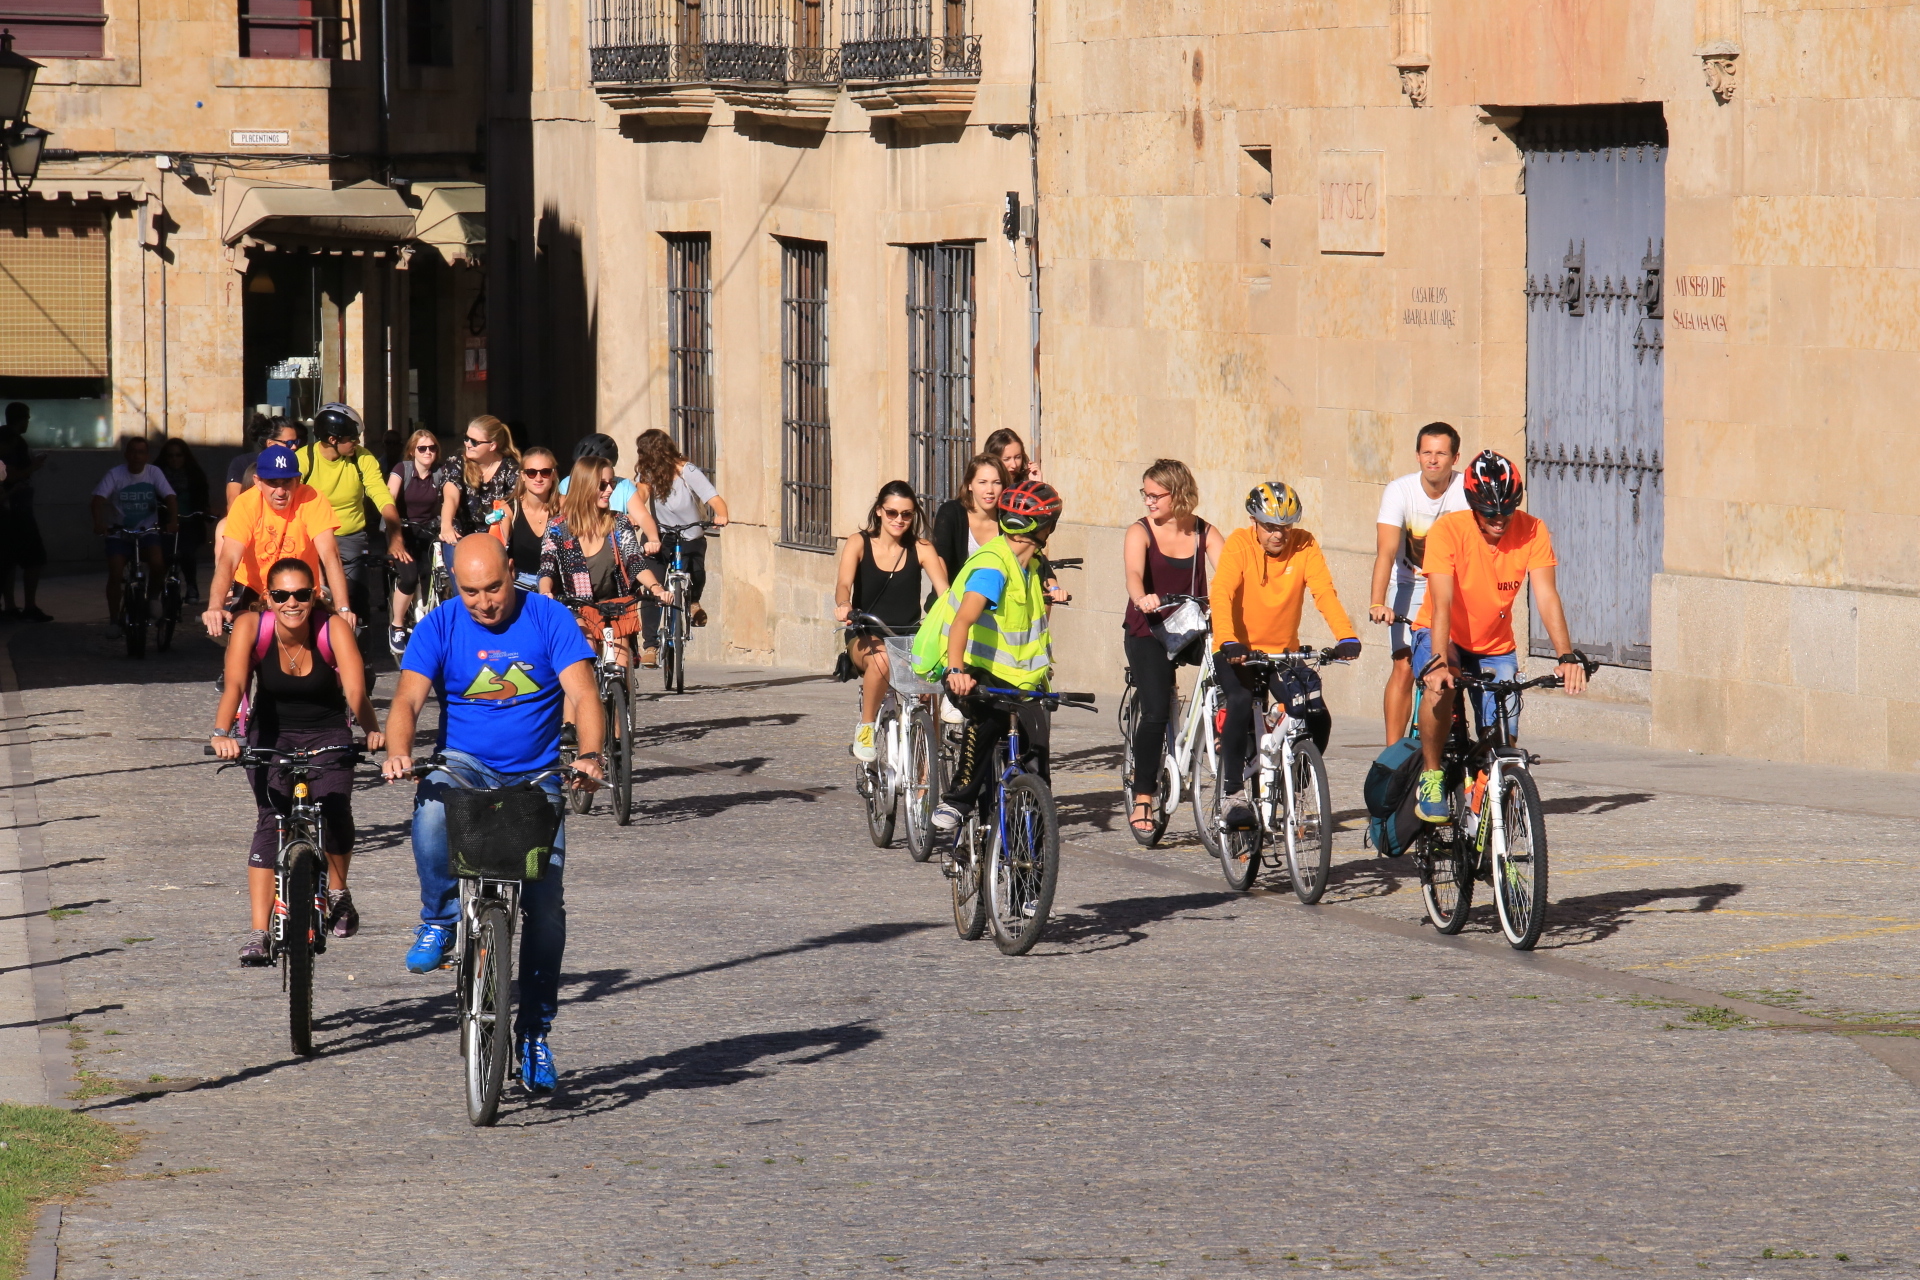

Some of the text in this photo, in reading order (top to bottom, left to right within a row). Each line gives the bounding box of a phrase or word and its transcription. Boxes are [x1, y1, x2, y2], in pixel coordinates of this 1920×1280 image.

[241, 134, 280, 143] PLACENTINOS
[1411, 286, 1428, 303] CASA
[1428, 286, 1436, 303] DE
[1711, 276, 1726, 298] DE
